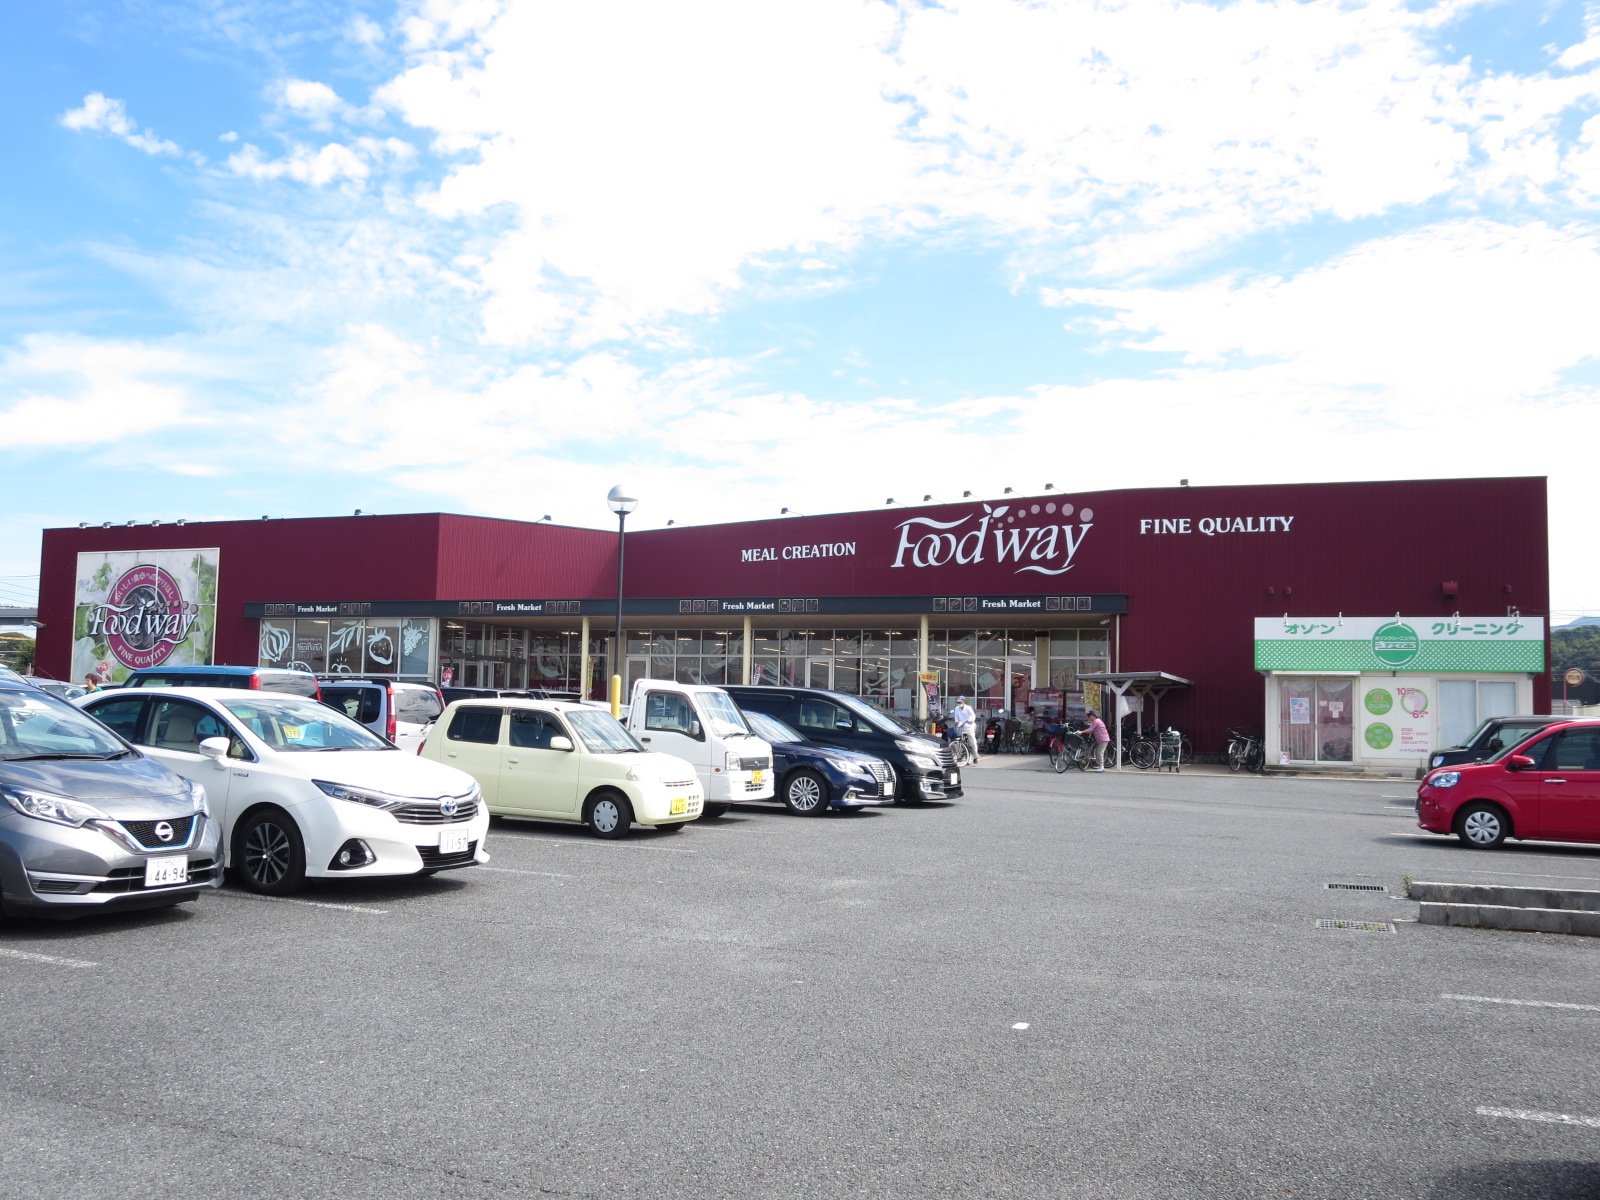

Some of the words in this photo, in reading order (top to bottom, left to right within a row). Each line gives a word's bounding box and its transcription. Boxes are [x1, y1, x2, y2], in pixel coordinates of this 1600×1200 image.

[1140, 518, 1192, 534] FINE
[1199, 516, 1294, 536] QUALITY
[741, 548, 778, 562] MEAL
[782, 542, 856, 559] CREATION
[315, 605, 338, 613] Market
[722, 602, 744, 610] Fresh
[746, 601, 775, 610] Market
[982, 600, 1007, 608] Fresh
[1009, 599, 1041, 608] Market
[1284, 624, 1335, 635] オゾン
[1431, 623, 1524, 636] クリーニング
[117, 645, 133, 662] FINE
[134, 645, 167, 666] QUALITY
[154, 867, 184, 883] 44-94
